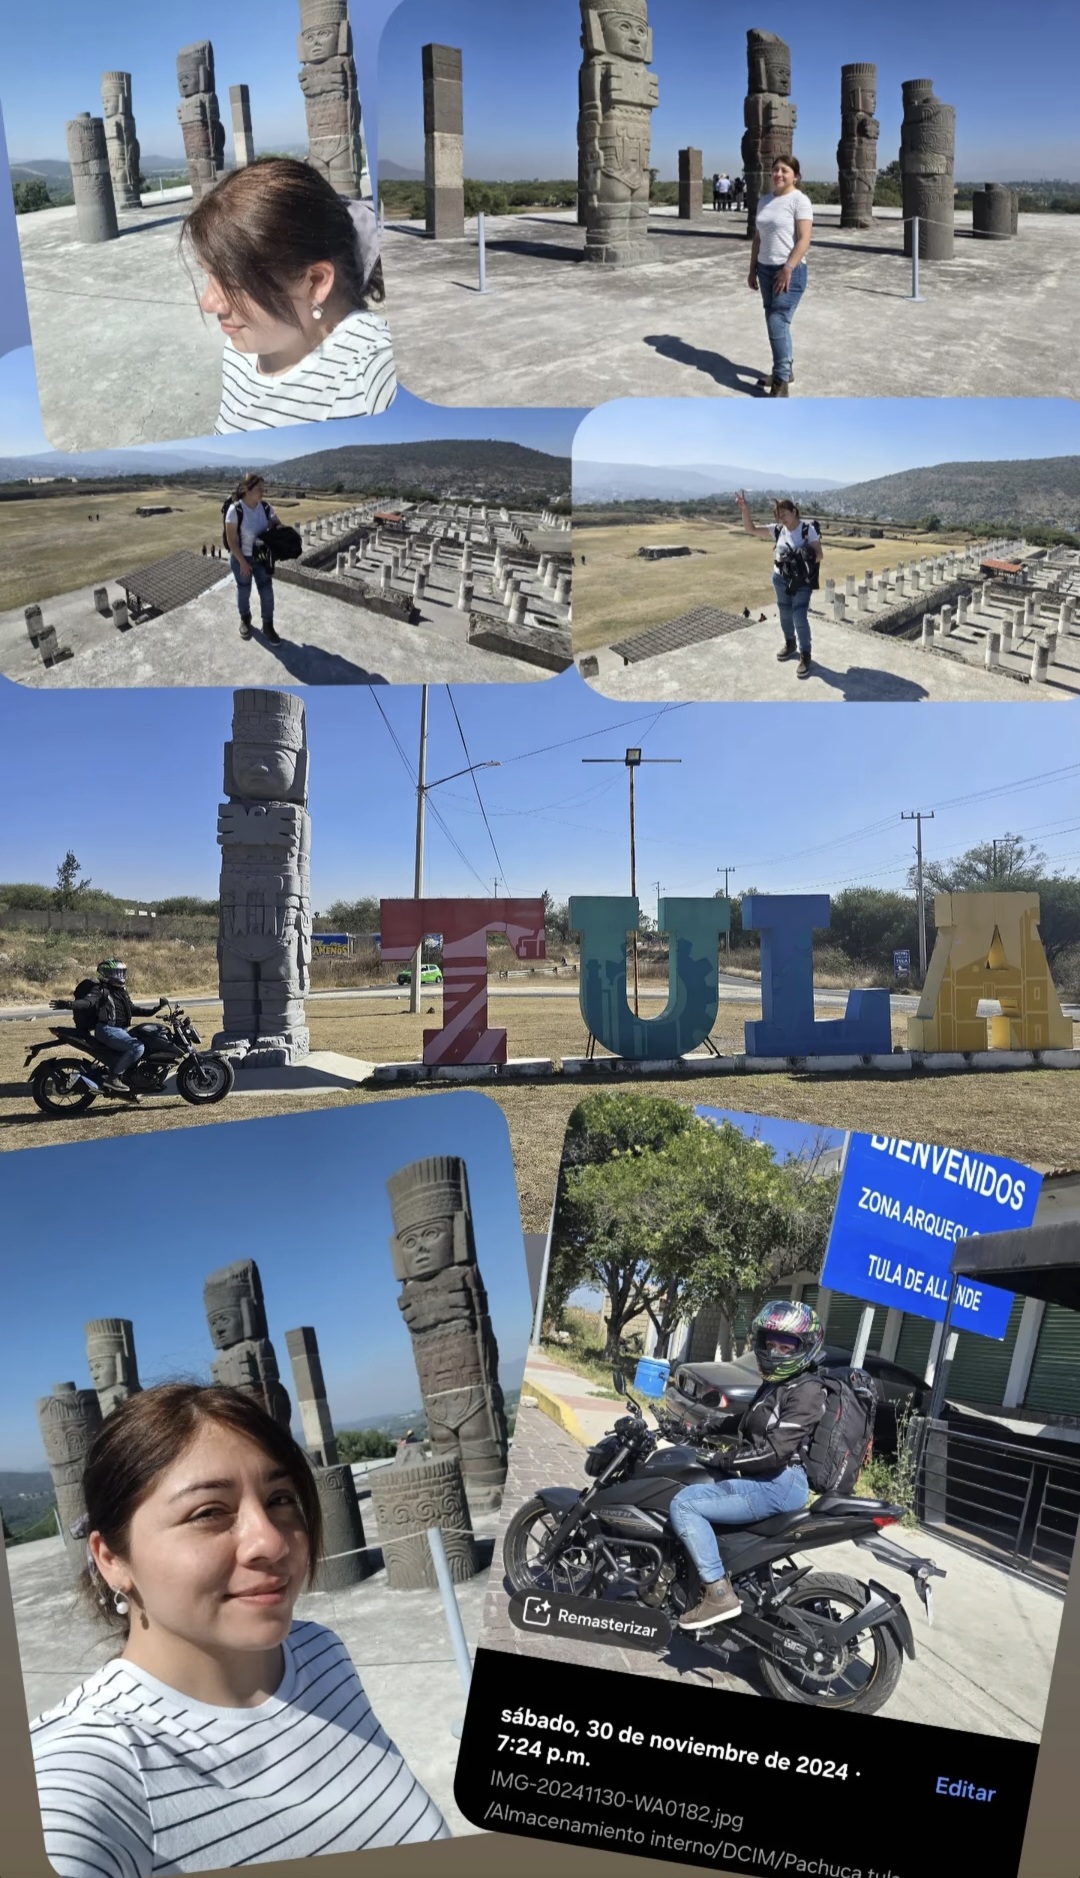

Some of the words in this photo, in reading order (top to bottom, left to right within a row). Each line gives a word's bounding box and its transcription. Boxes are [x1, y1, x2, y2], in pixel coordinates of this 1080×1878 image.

[380, 891, 1073, 1064] TULA
[858, 1187, 901, 1222] ZONA
[868, 1254, 902, 1286] TULA
[904, 1267, 925, 1293] DE
[925, 1275, 982, 1312] ALLNDE
